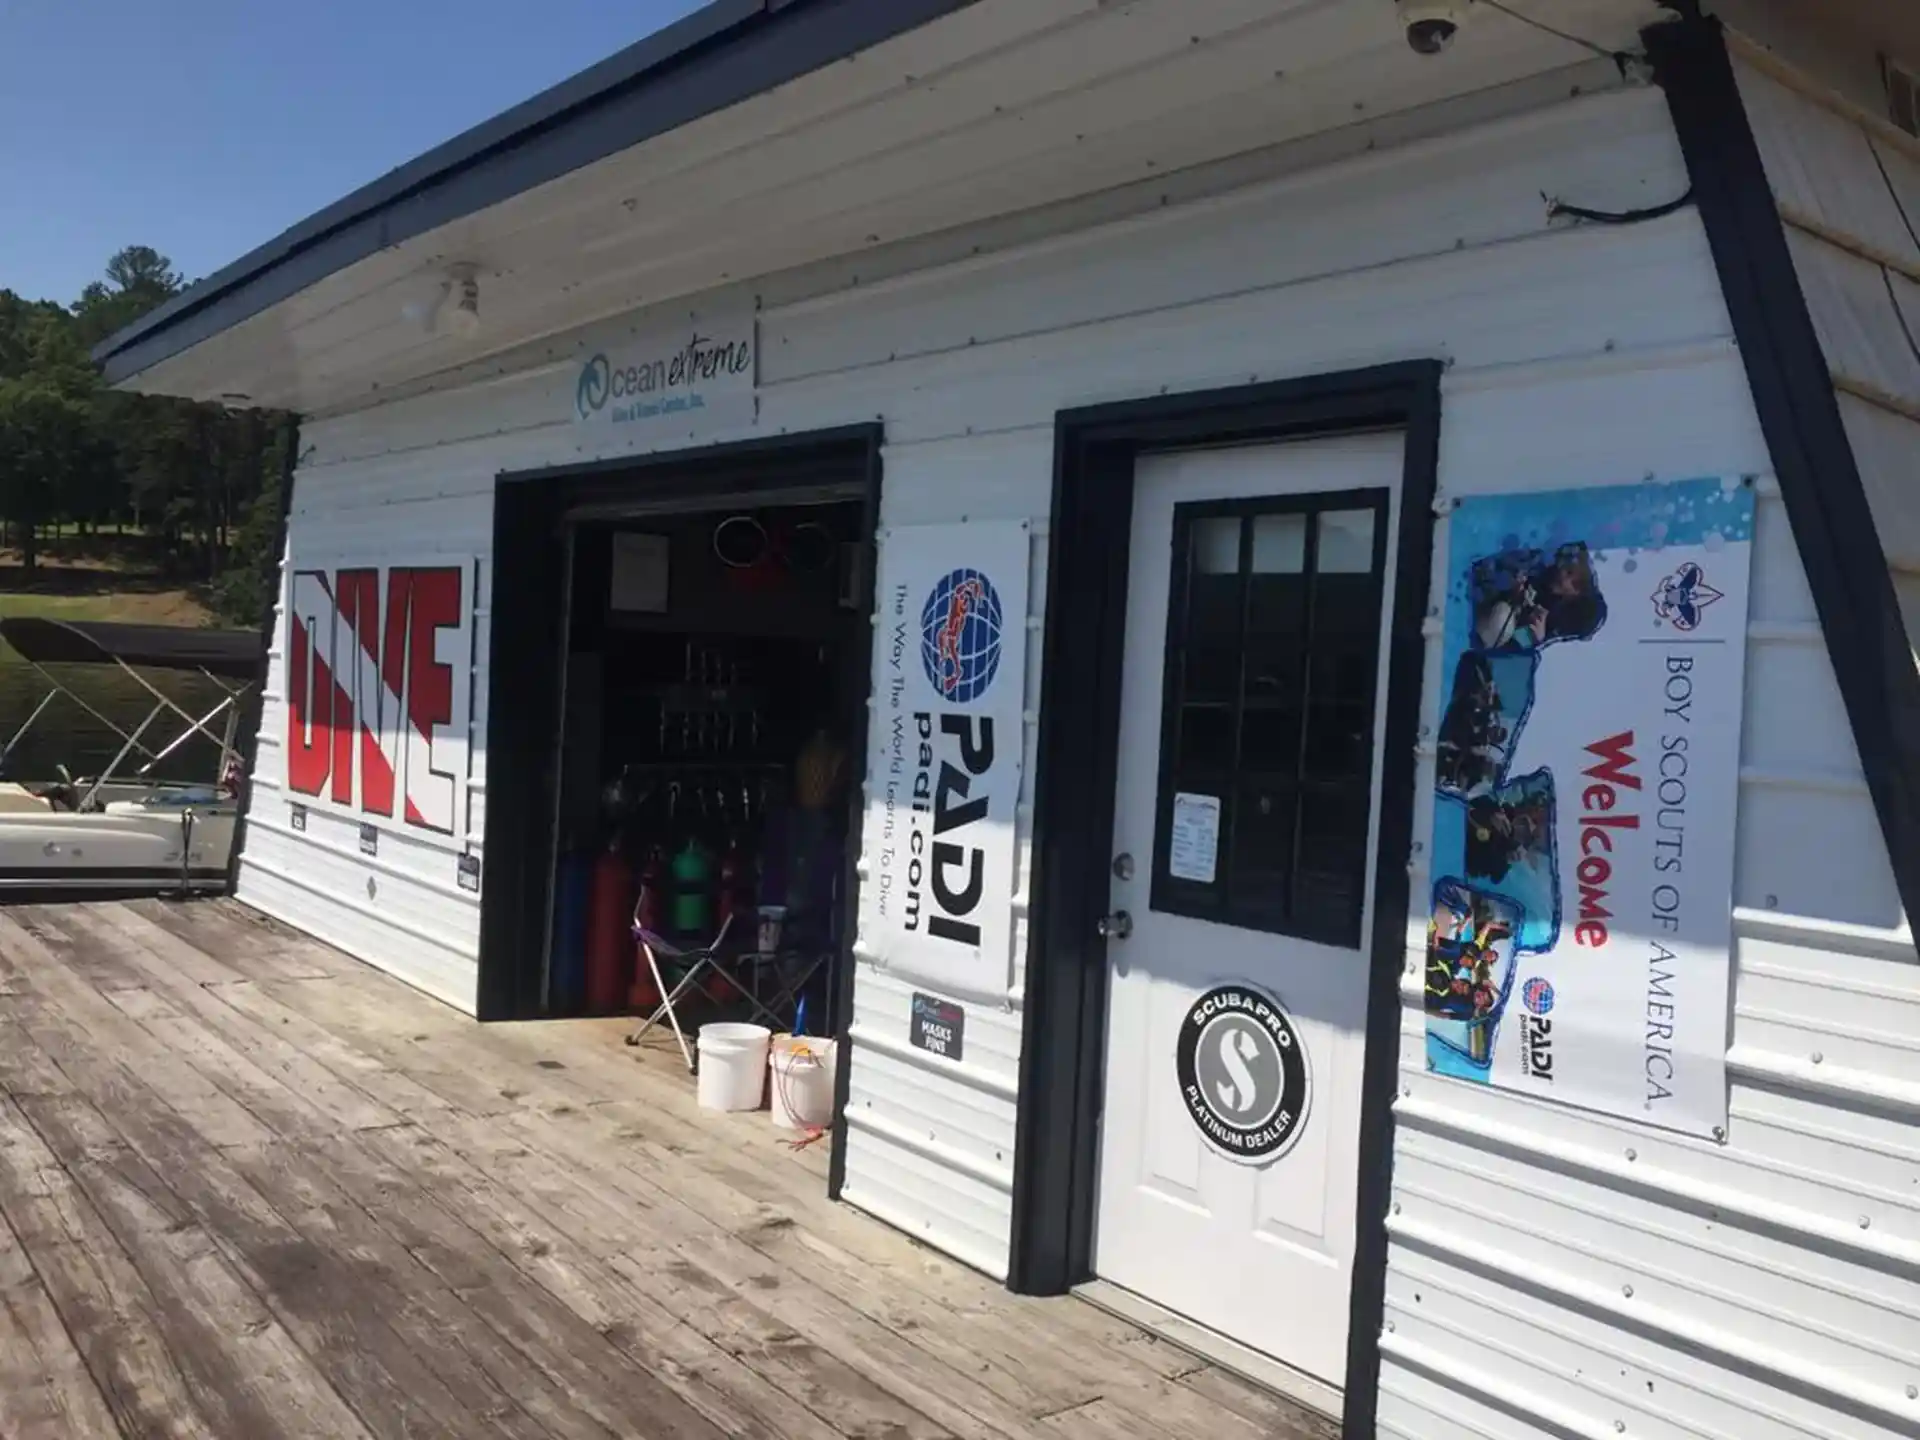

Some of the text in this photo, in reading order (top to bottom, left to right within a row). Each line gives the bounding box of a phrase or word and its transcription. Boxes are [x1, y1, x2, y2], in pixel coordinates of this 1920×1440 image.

[583, 352, 665, 411] Ocean
[667, 332, 749, 387] extreme
[895, 584, 908, 615] The
[889, 622, 907, 670] Way
[288, 565, 462, 836] DIVE
[891, 677, 905, 708] The
[890, 715, 905, 774] World
[884, 781, 900, 839] Learns
[904, 712, 933, 931] padi.com
[927, 713, 994, 947] PADI
[881, 847, 895, 867] To
[1645, 656, 1693, 1101] BOY SCOUTS OF AMERICA
[922, 1020, 952, 1042] MASKS
[1193, 993, 1292, 1048] SCUBAPRO
[1530, 1016, 1553, 1081] PADI
[1186, 1085, 1292, 1149] PLATINUM DEALER
